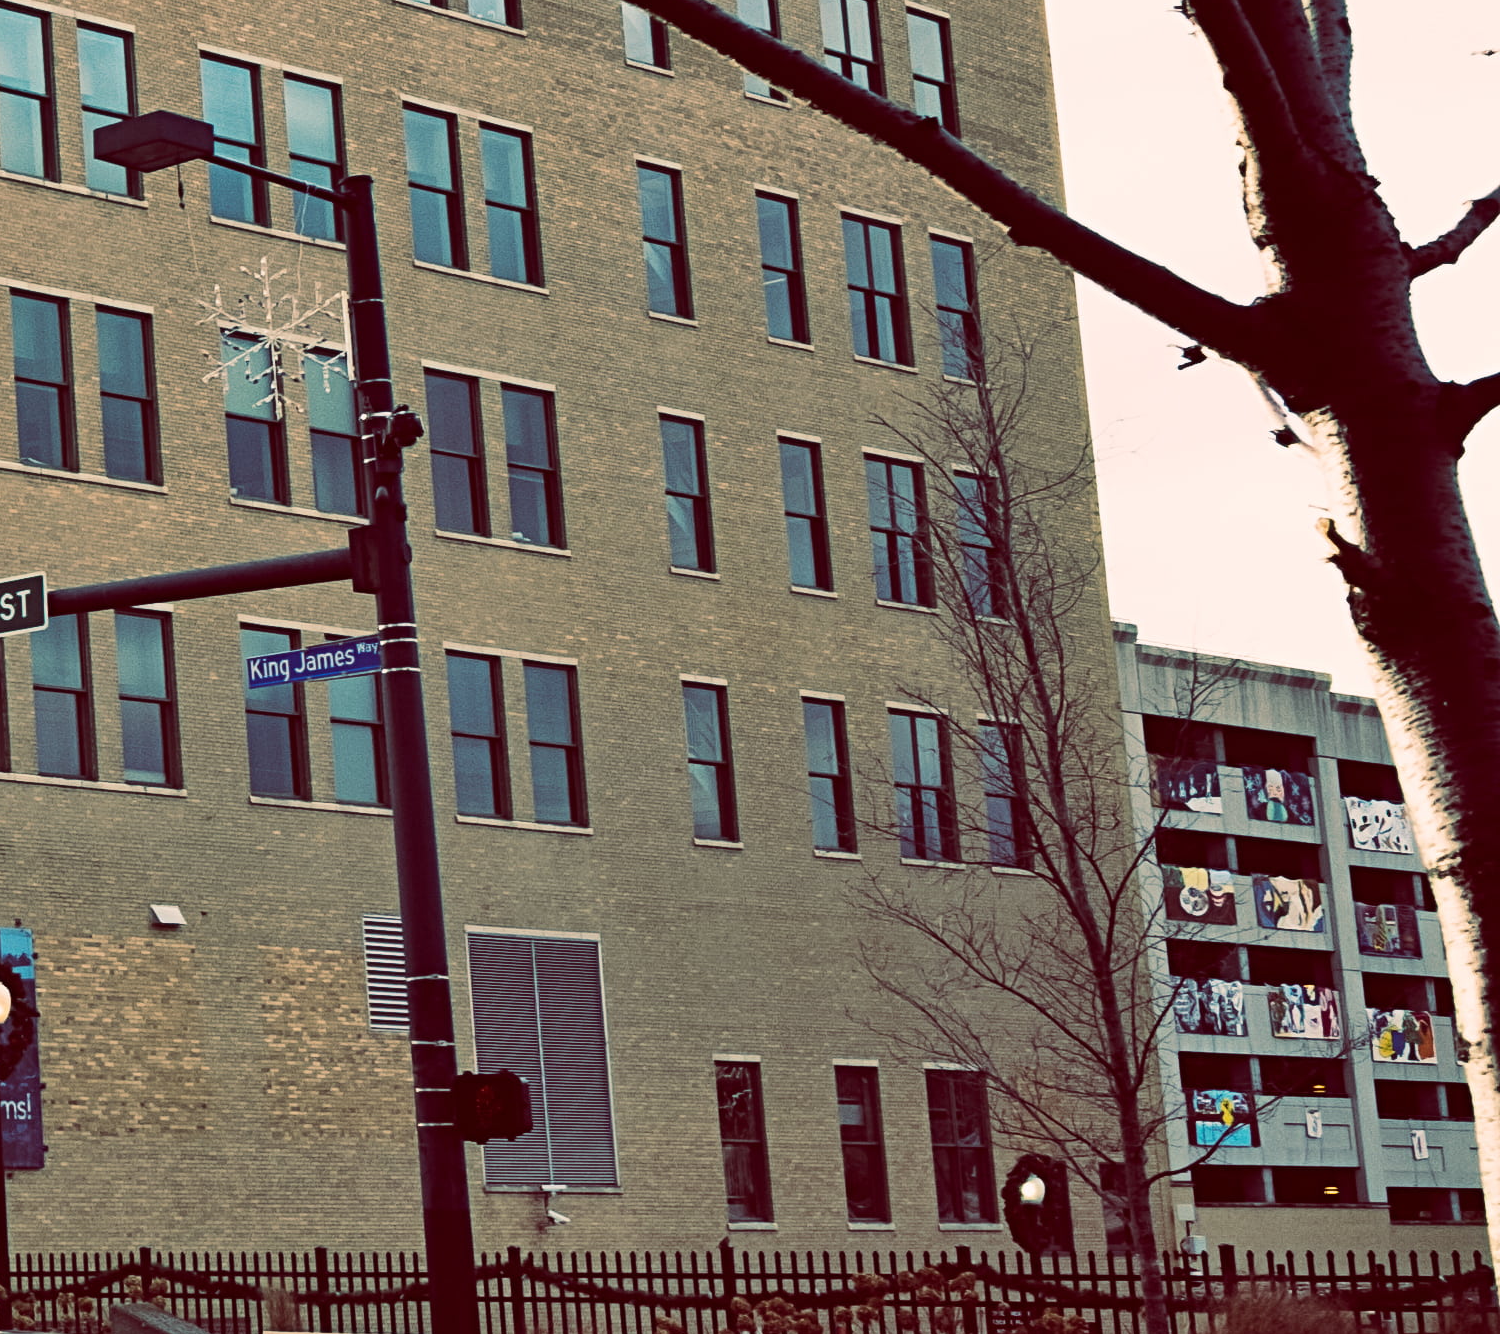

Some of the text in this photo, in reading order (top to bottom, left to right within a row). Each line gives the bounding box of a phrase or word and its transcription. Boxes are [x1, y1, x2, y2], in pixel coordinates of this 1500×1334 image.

[0, 589, 32, 622] ST
[249, 641, 379, 682] King James Way
